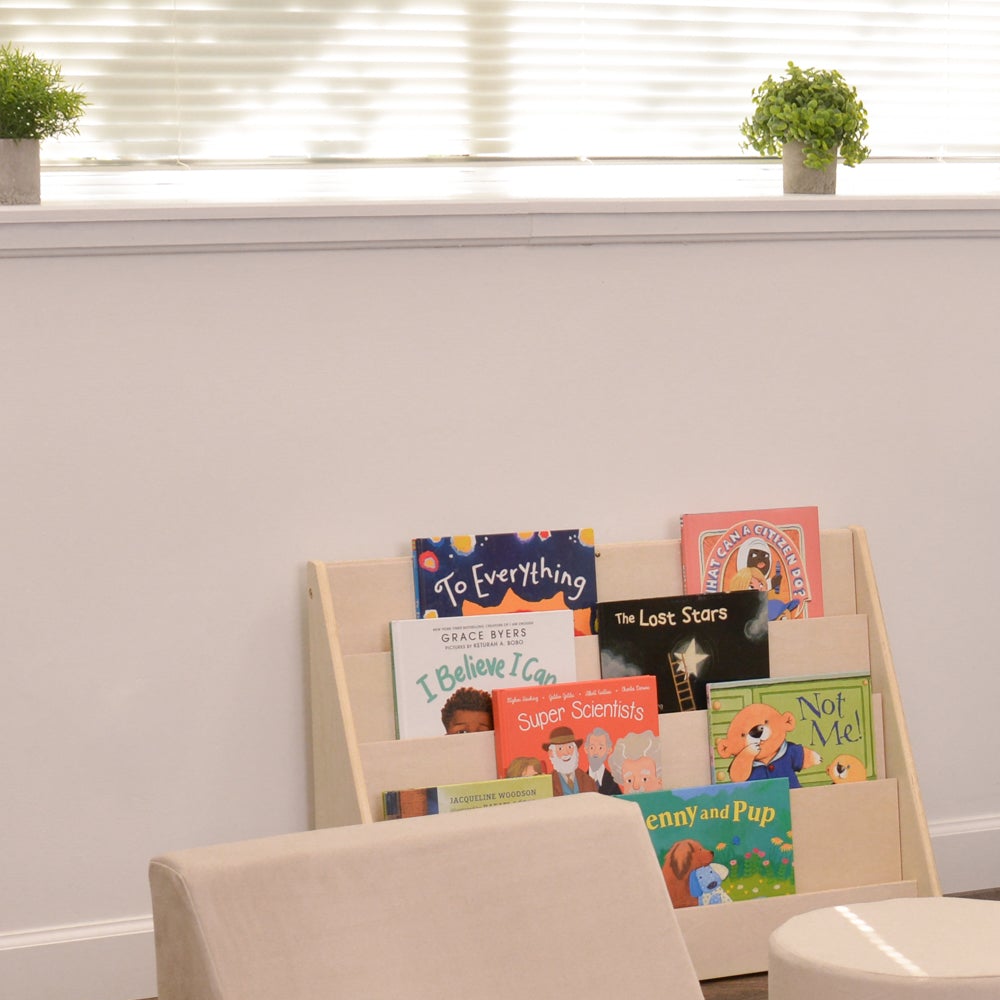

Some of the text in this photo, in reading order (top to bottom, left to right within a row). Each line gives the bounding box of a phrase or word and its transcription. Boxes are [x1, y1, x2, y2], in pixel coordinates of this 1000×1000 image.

[705, 559, 721, 593] HAT
[716, 530, 741, 559] CAN
[742, 525, 751, 536] A
[753, 524, 798, 566] CITIZEN
[434, 556, 587, 608] To Everything
[615, 605, 728, 627] The Lost Stars
[441, 628, 527, 643] GRACE BYERS
[473, 641, 498, 649] KETURAH
[415, 652, 557, 704] I Believe I Can
[517, 699, 645, 732] Super Scientists
[796, 691, 846, 721] Not
[809, 709, 863, 747] Me!
[450, 789, 537, 805] JACQUELINE WOODSON
[645, 799, 776, 831] enny and Pup
